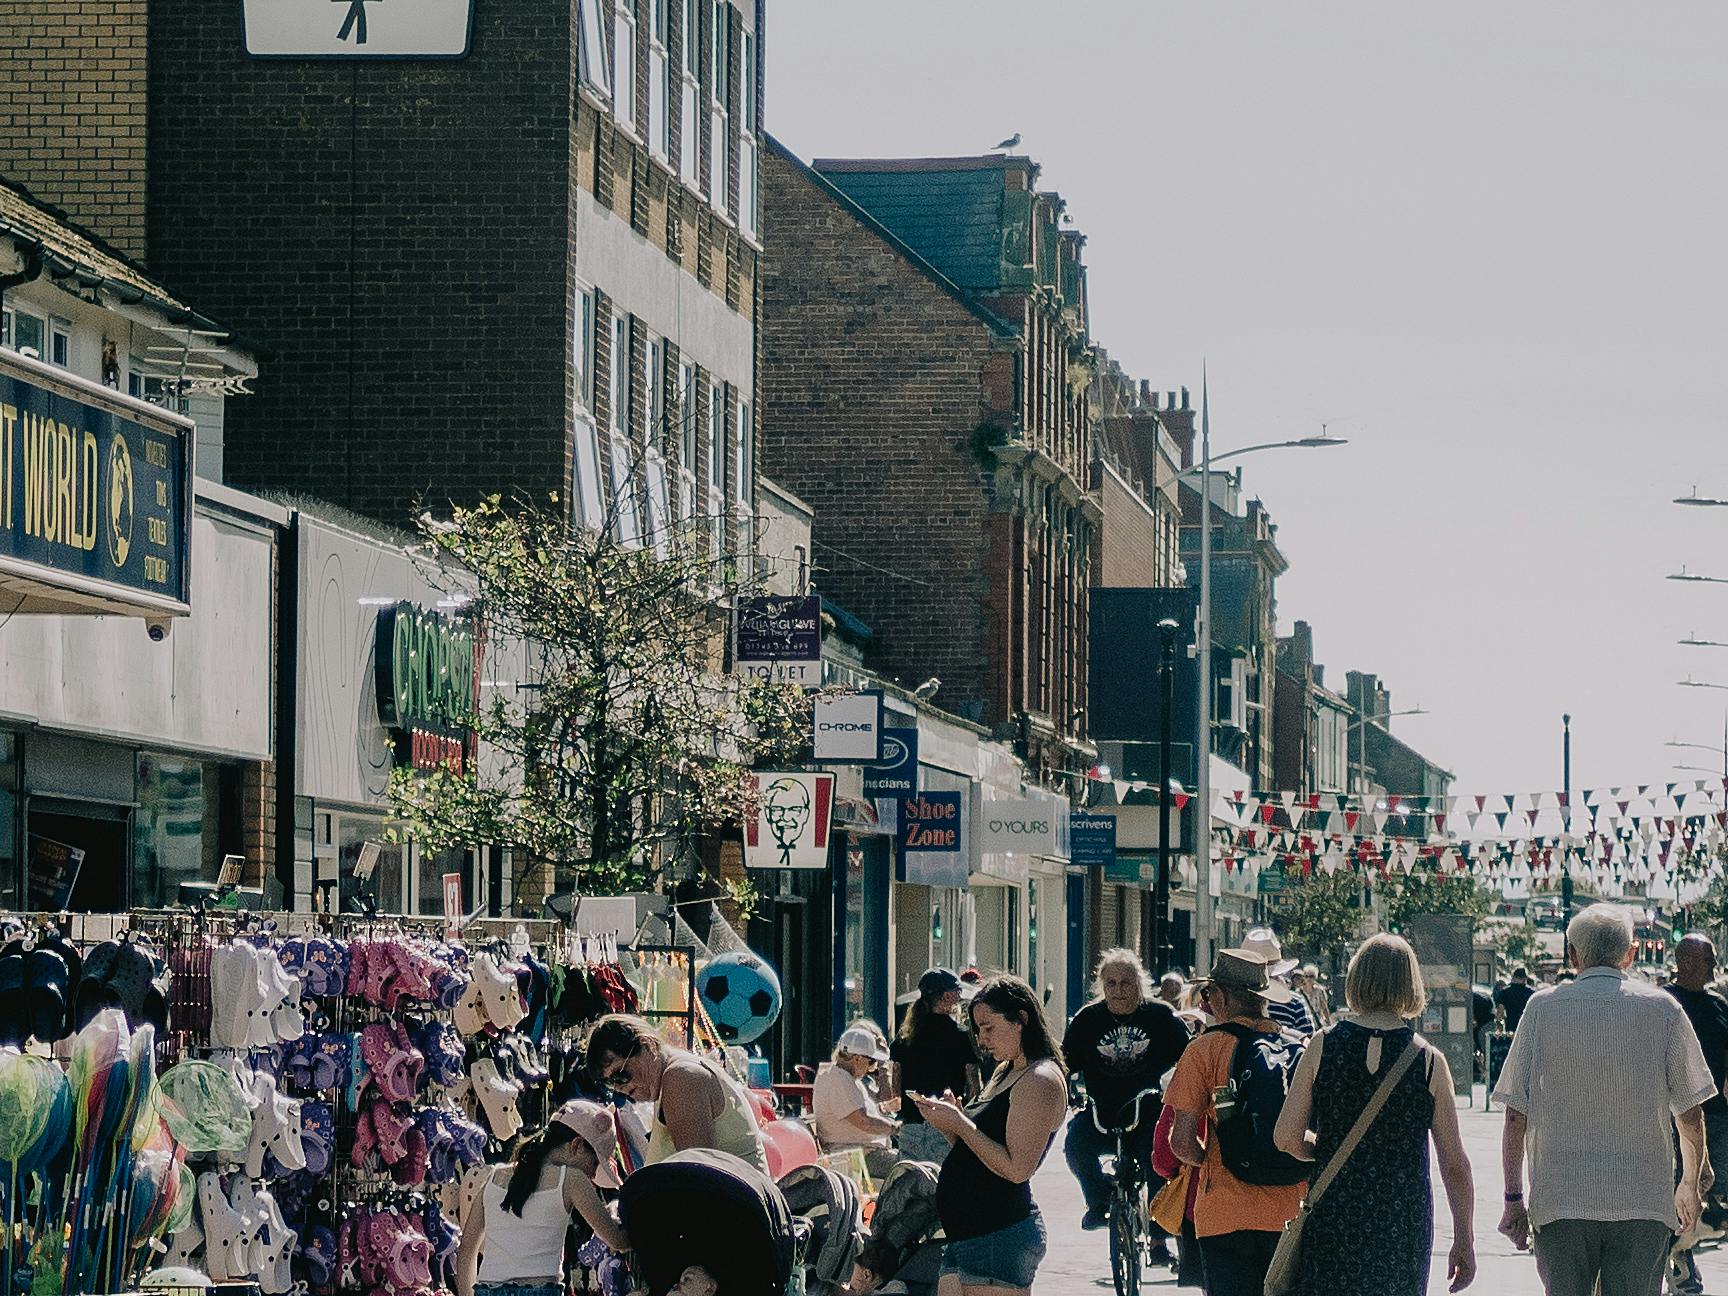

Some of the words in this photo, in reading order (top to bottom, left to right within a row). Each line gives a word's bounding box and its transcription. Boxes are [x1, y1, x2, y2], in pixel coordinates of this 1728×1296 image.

[24, 410, 97, 551] WORLD
[819, 722, 872, 732] CHROME
[905, 796, 956, 820] Shoe
[1004, 820, 1049, 834] YOURS
[1071, 817, 1113, 830] scrivens
[905, 822, 956, 846] Zone
